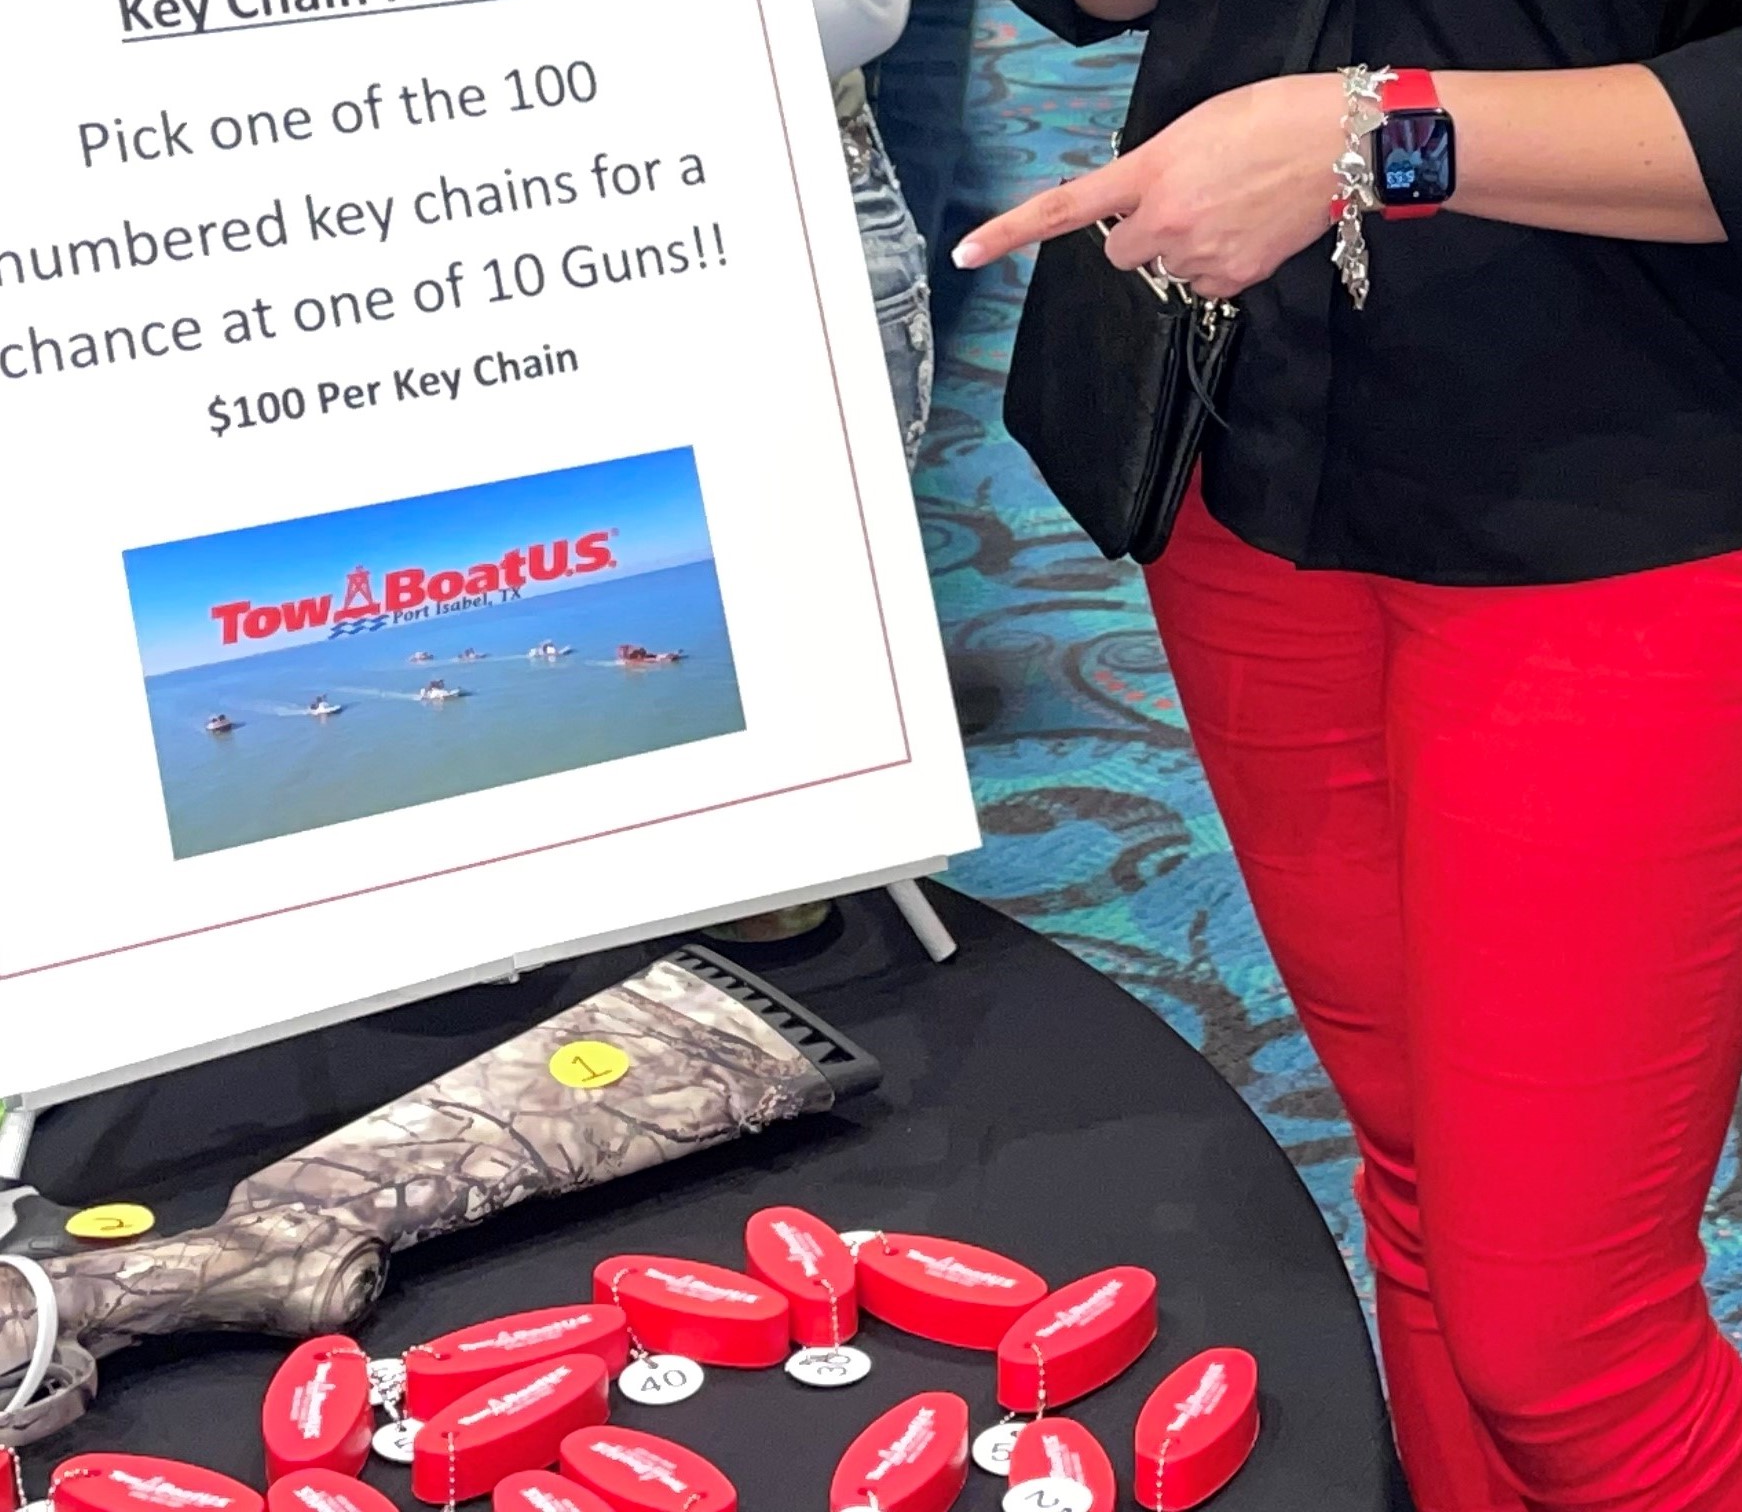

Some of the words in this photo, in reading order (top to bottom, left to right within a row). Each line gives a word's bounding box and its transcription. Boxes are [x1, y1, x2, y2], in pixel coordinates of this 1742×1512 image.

[79, 110, 194, 168] Pick
[210, 107, 313, 150] one
[332, 83, 383, 134] of
[400, 76, 487, 125] the
[505, 60, 597, 111] 100
[0, 198, 288, 287] numbered
[306, 194, 394, 243] key
[414, 167, 578, 225] chains
[592, 153, 661, 198] for
[679, 154, 706, 186] a
[0, 317, 203, 380] chance
[222, 298, 277, 344] at
[294, 287, 395, 332] one
[414, 261, 464, 313] of
[484, 253, 545, 304] 10
[561, 222, 727, 289] Guns!!
[208, 388, 305, 437] $100
[317, 377, 381, 415] Per
[394, 364, 462, 402] Key
[474, 342, 579, 387] Chain
[211, 594, 333, 645] Tow
[393, 605, 430, 624] Port
[435, 593, 493, 615] Isabel,
[501, 587, 522, 603] TX
[570, 1054, 612, 1082] 1
[640, 1369, 687, 1392] 40
